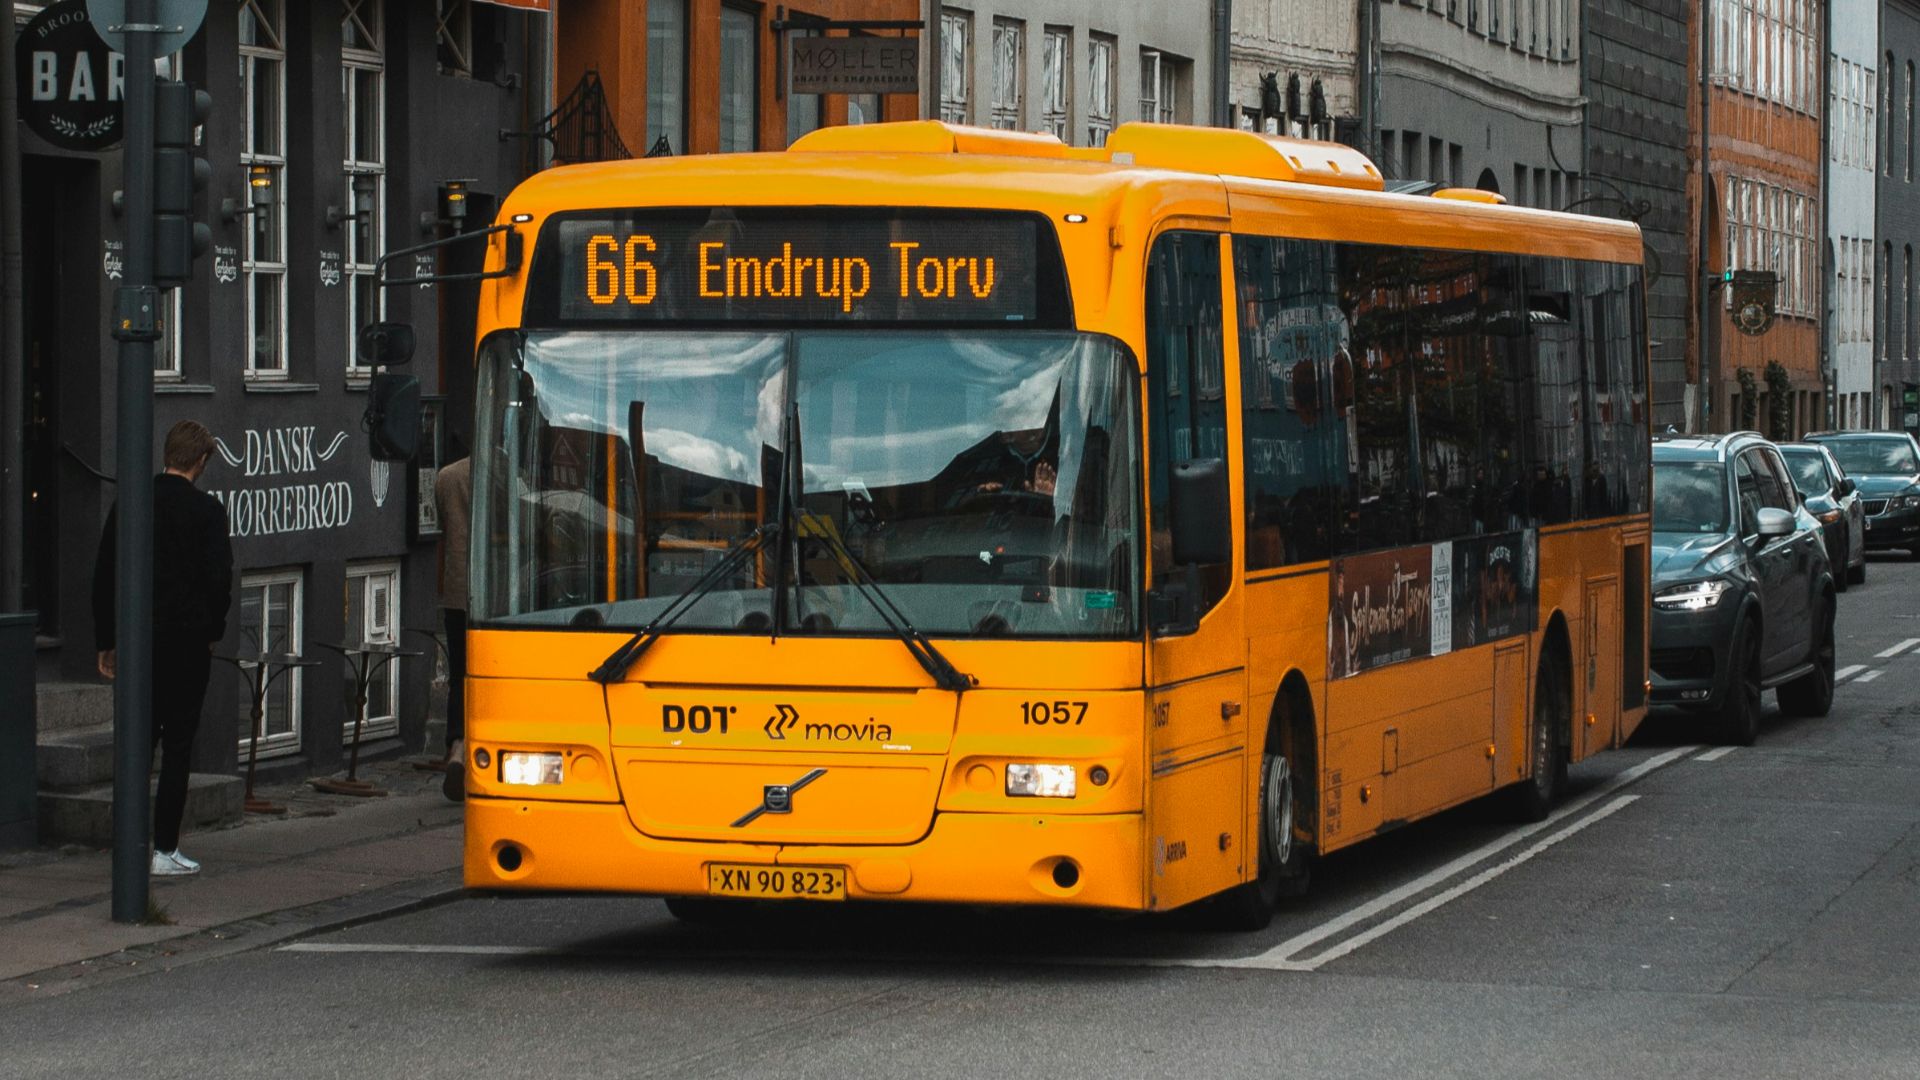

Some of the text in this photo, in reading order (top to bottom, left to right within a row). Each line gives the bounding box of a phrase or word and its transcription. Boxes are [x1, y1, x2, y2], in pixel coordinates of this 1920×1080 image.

[37, 10, 85, 38] BROO
[793, 47, 916, 69] MØLLER
[32, 51, 125, 101] BAR
[587, 235, 994, 312] 66 Emdrup Torv
[244, 426, 317, 477] DANSK
[208, 481, 352, 537] MØRREBRØD
[662, 704, 729, 734] DOT
[1020, 701, 1089, 726] 1057
[1154, 702, 1170, 729] 1057
[805, 717, 892, 742] movia
[1166, 841, 1187, 864] ARRIVA
[720, 869, 834, 894] XN 90 823
